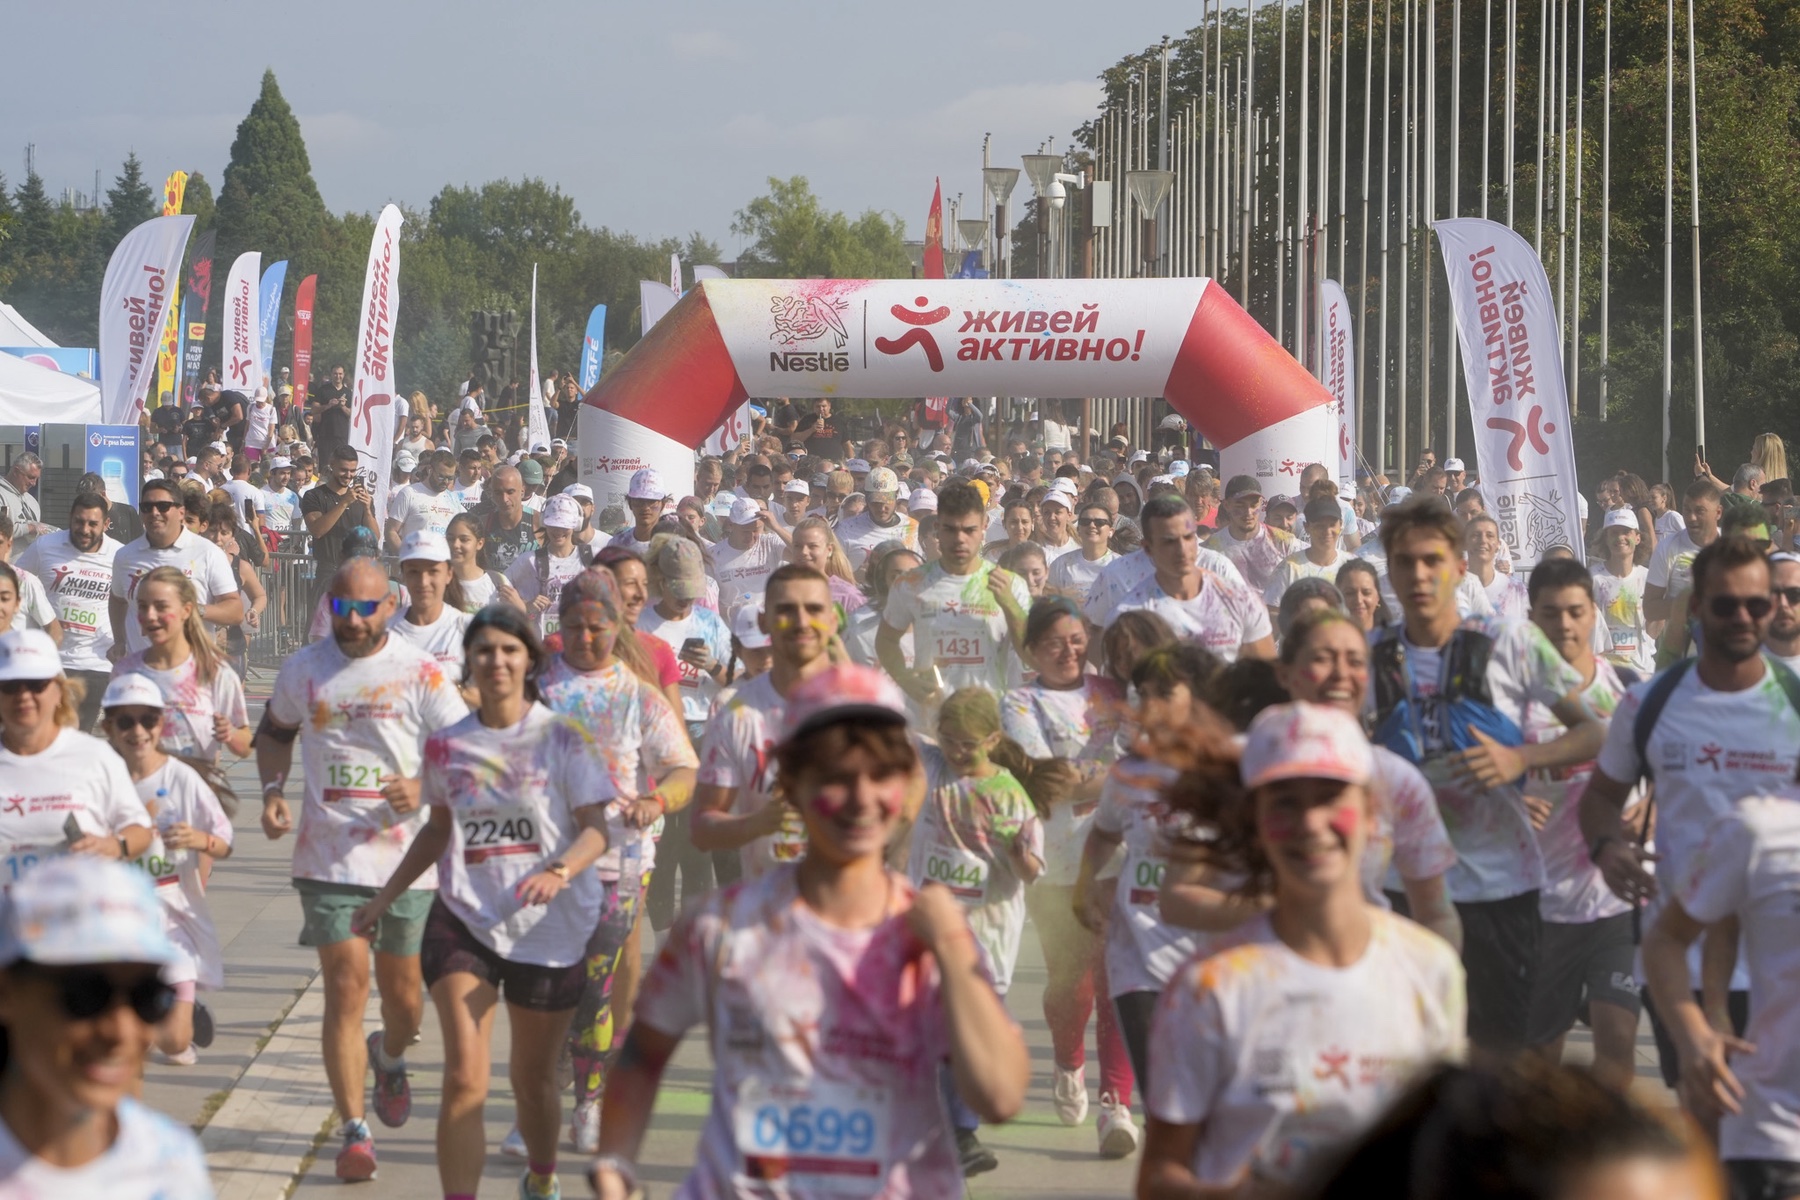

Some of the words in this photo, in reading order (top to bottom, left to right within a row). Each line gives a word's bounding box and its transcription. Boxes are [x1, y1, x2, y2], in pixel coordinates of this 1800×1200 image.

[63, 607, 97, 626] 1560
[936, 638, 980, 656] 1431
[678, 661, 699, 679] 94
[327, 764, 382, 788] 1521
[464, 817, 534, 846] 2240
[927, 855, 982, 888] 0044
[753, 1106, 876, 1155] 0699
